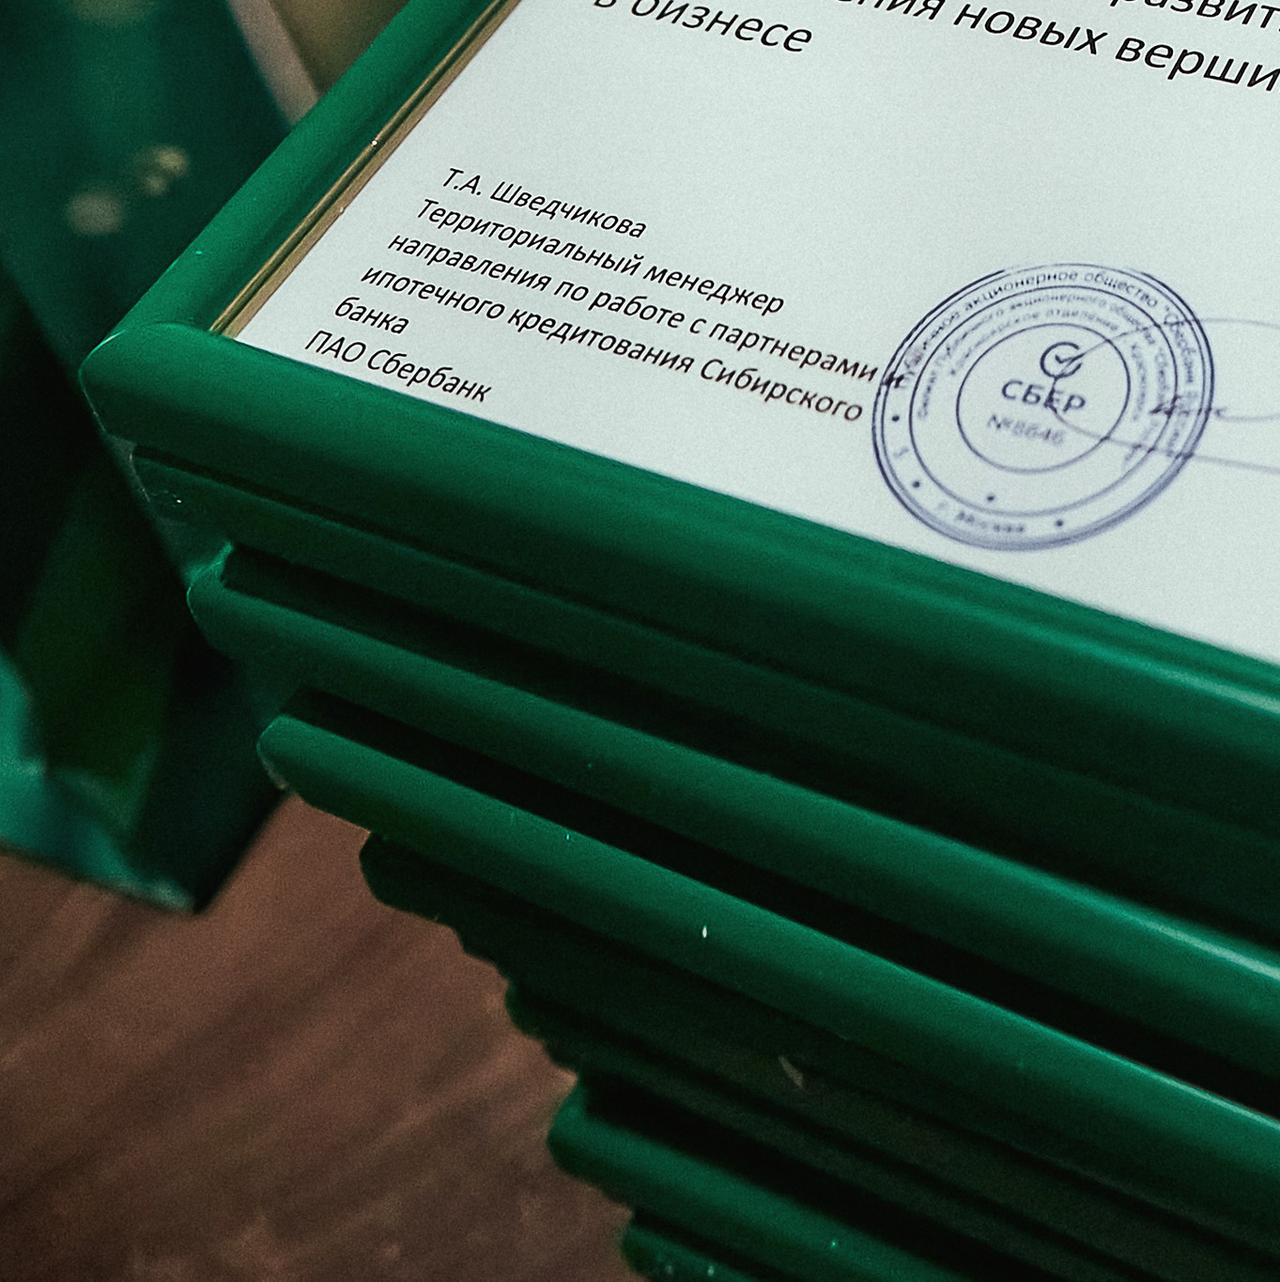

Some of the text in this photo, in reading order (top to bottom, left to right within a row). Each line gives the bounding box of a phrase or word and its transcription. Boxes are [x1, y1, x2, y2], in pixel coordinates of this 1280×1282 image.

[953, 0, 1108, 56] новых
[442, 168, 647, 239] Т.А. Шведчикова
[416, 198, 785, 317] Территориальный менеджер
[334, 296, 410, 335] банка
[361, 267, 506, 320] ипотечного
[508, 308, 695, 374] кредитования
[700, 358, 864, 422] Сибирского
[387, 234, 552, 292] направления
[554, 279, 589, 303] по
[588, 290, 685, 330] работе
[690, 317, 708, 334] с
[709, 322, 879, 383] партнерами
[305, 330, 492, 403] ПАО Сбербанк
[1001, 379, 1086, 413] СБЕР
